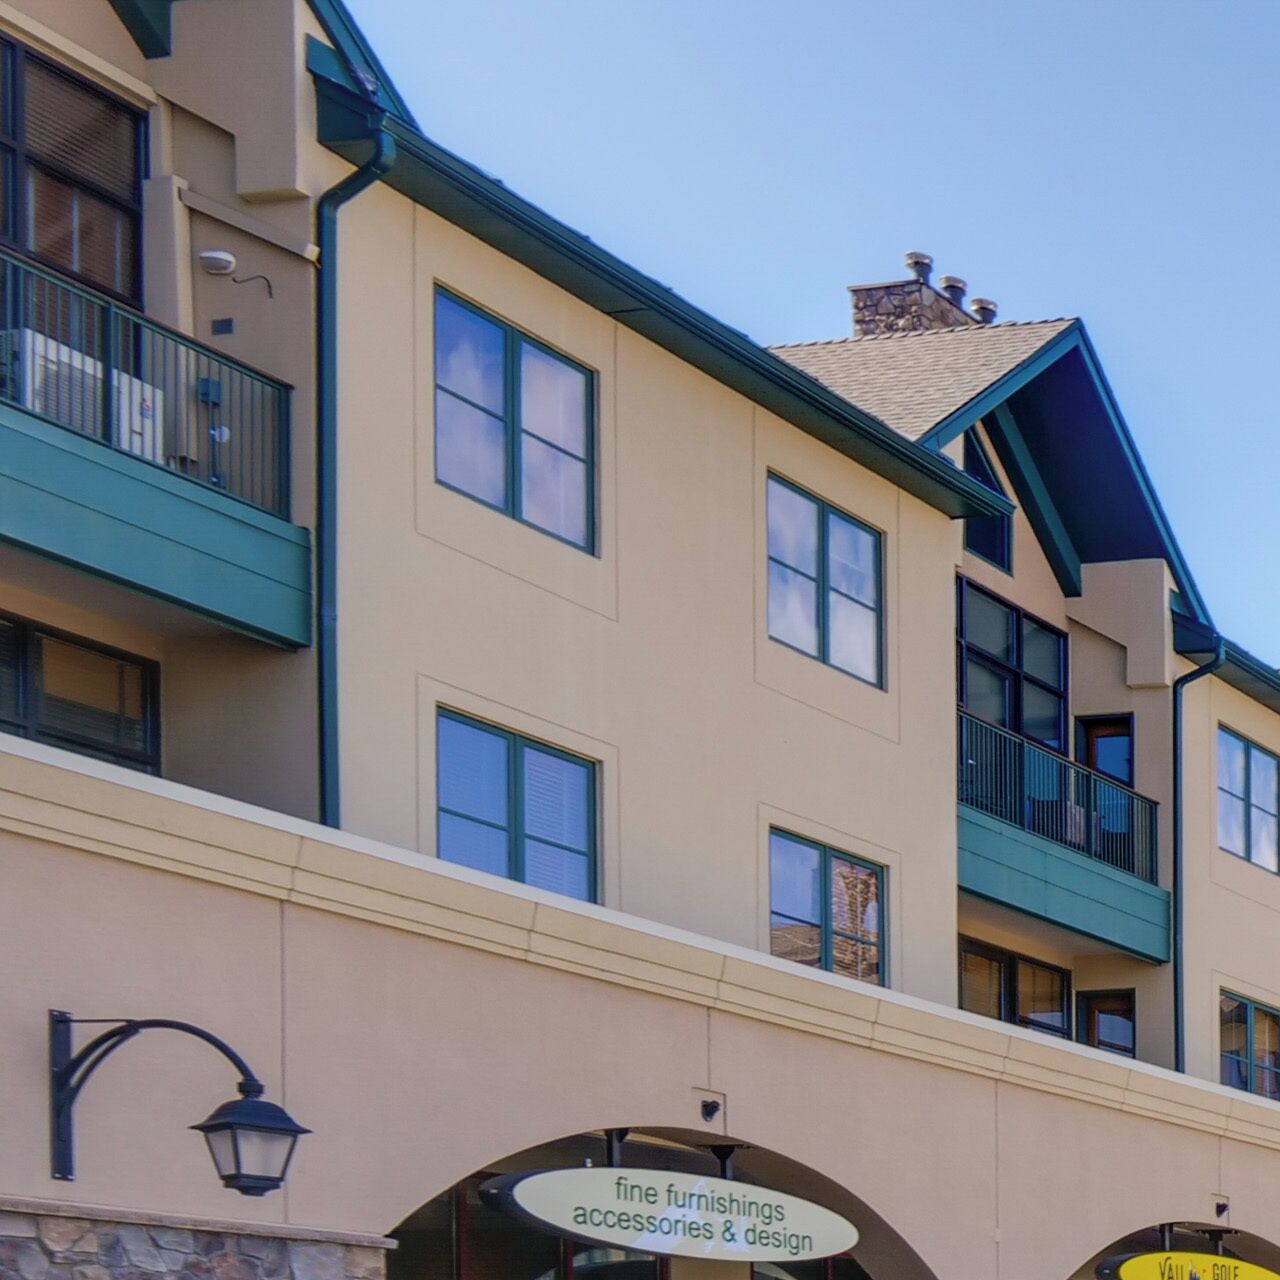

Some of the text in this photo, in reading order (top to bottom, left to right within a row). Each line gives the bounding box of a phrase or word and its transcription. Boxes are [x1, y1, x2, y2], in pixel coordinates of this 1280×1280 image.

[615, 1177, 785, 1225] fine furnishings
[573, 1206, 813, 1255] accessories & design
